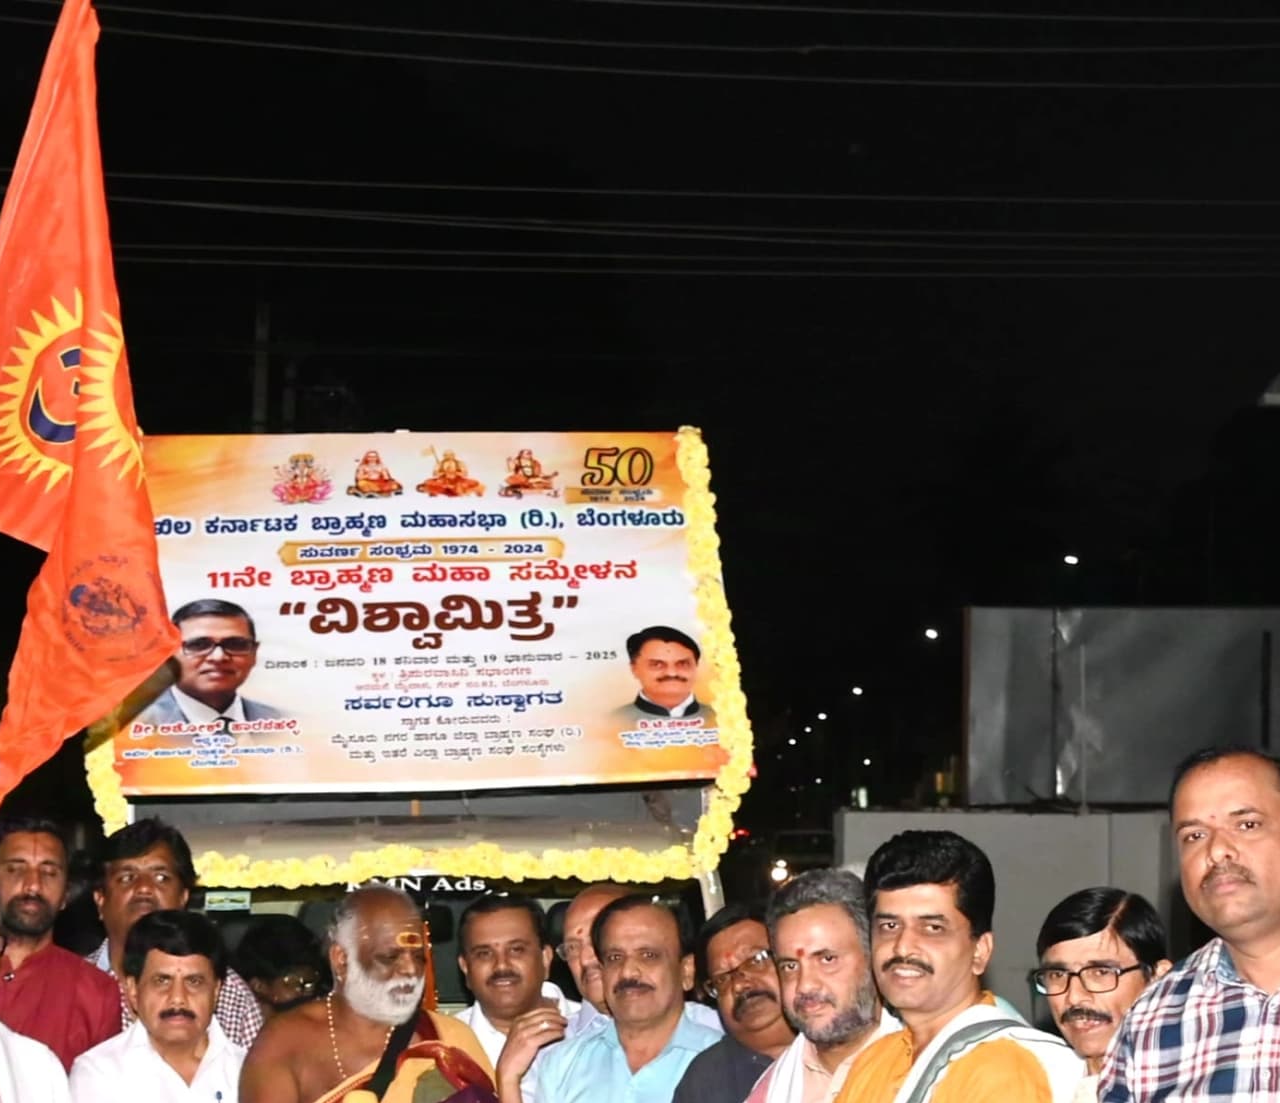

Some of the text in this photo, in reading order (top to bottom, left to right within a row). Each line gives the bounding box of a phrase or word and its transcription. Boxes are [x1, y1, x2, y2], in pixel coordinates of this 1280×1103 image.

[581, 447, 654, 487] 50
[154, 517, 192, 536] ಖಿಲ
[205, 514, 298, 535] ಕರ್ನಾಟಕ
[311, 512, 387, 537] ಬ್ರಾಹ್ಮಣ
[401, 510, 507, 531] ಮಹಾಸಭಾ
[577, 507, 685, 527] ಬೆಂಗಳೂರು
[299, 545, 360, 559] ಸುವರ್ಣ
[369, 543, 432, 558] ಸಂಭ್ರಮ
[442, 543, 478, 555] 1974
[504, 542, 544, 554] 2024
[207, 559, 638, 592] 11ನೇ ಬ್ರಾಹ್ಮಣ ಮಹಾ ಸಮ್ಮೇಳನ
[373, 656, 386, 666] 18
[483, 654, 497, 664] 19
[586, 650, 617, 660] 2025
[344, 690, 563, 712] ಸರ್ವರಿಗೂ ಸುಸ್ವಾಗತ
